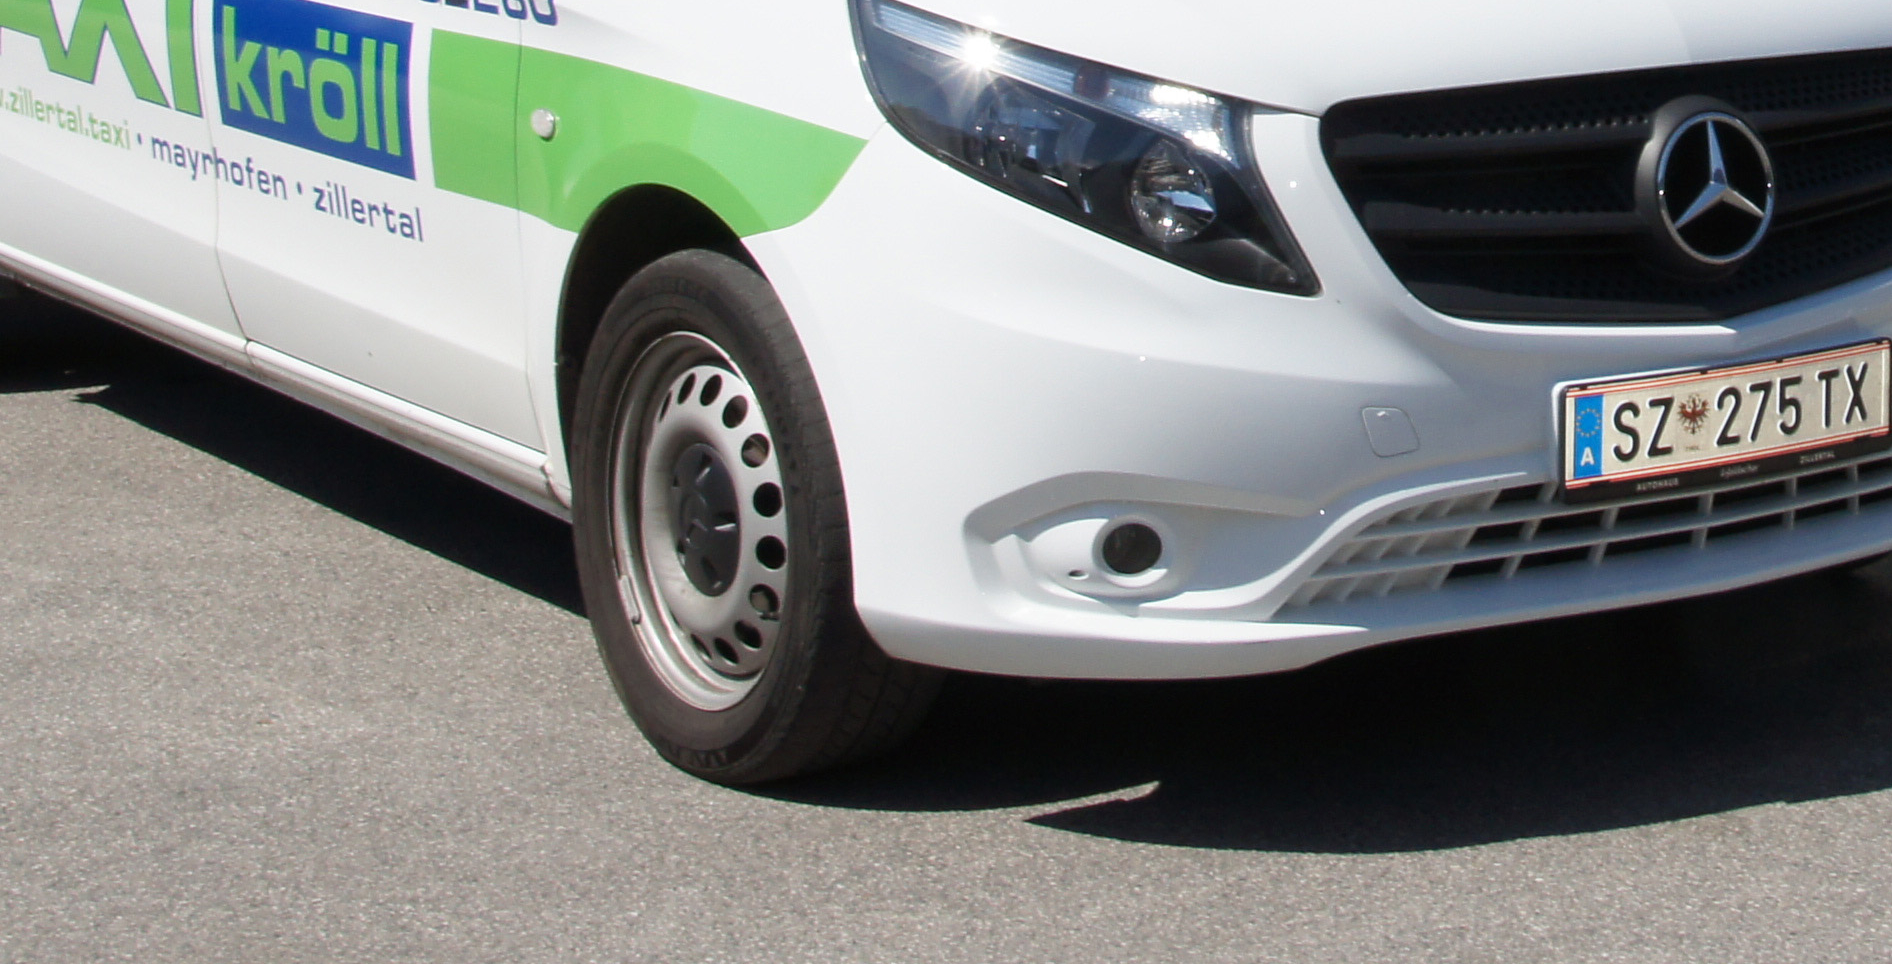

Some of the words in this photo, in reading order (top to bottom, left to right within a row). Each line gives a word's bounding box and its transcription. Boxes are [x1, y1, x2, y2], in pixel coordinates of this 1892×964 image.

[221, 4, 402, 158] kröll
[151, 135, 288, 201] mayrhofen
[312, 180, 425, 243] zillertal
[1579, 446, 1596, 467] A
[1612, 396, 1676, 463] SZ
[1714, 374, 1804, 448] 275
[1815, 361, 1870, 429] TX
